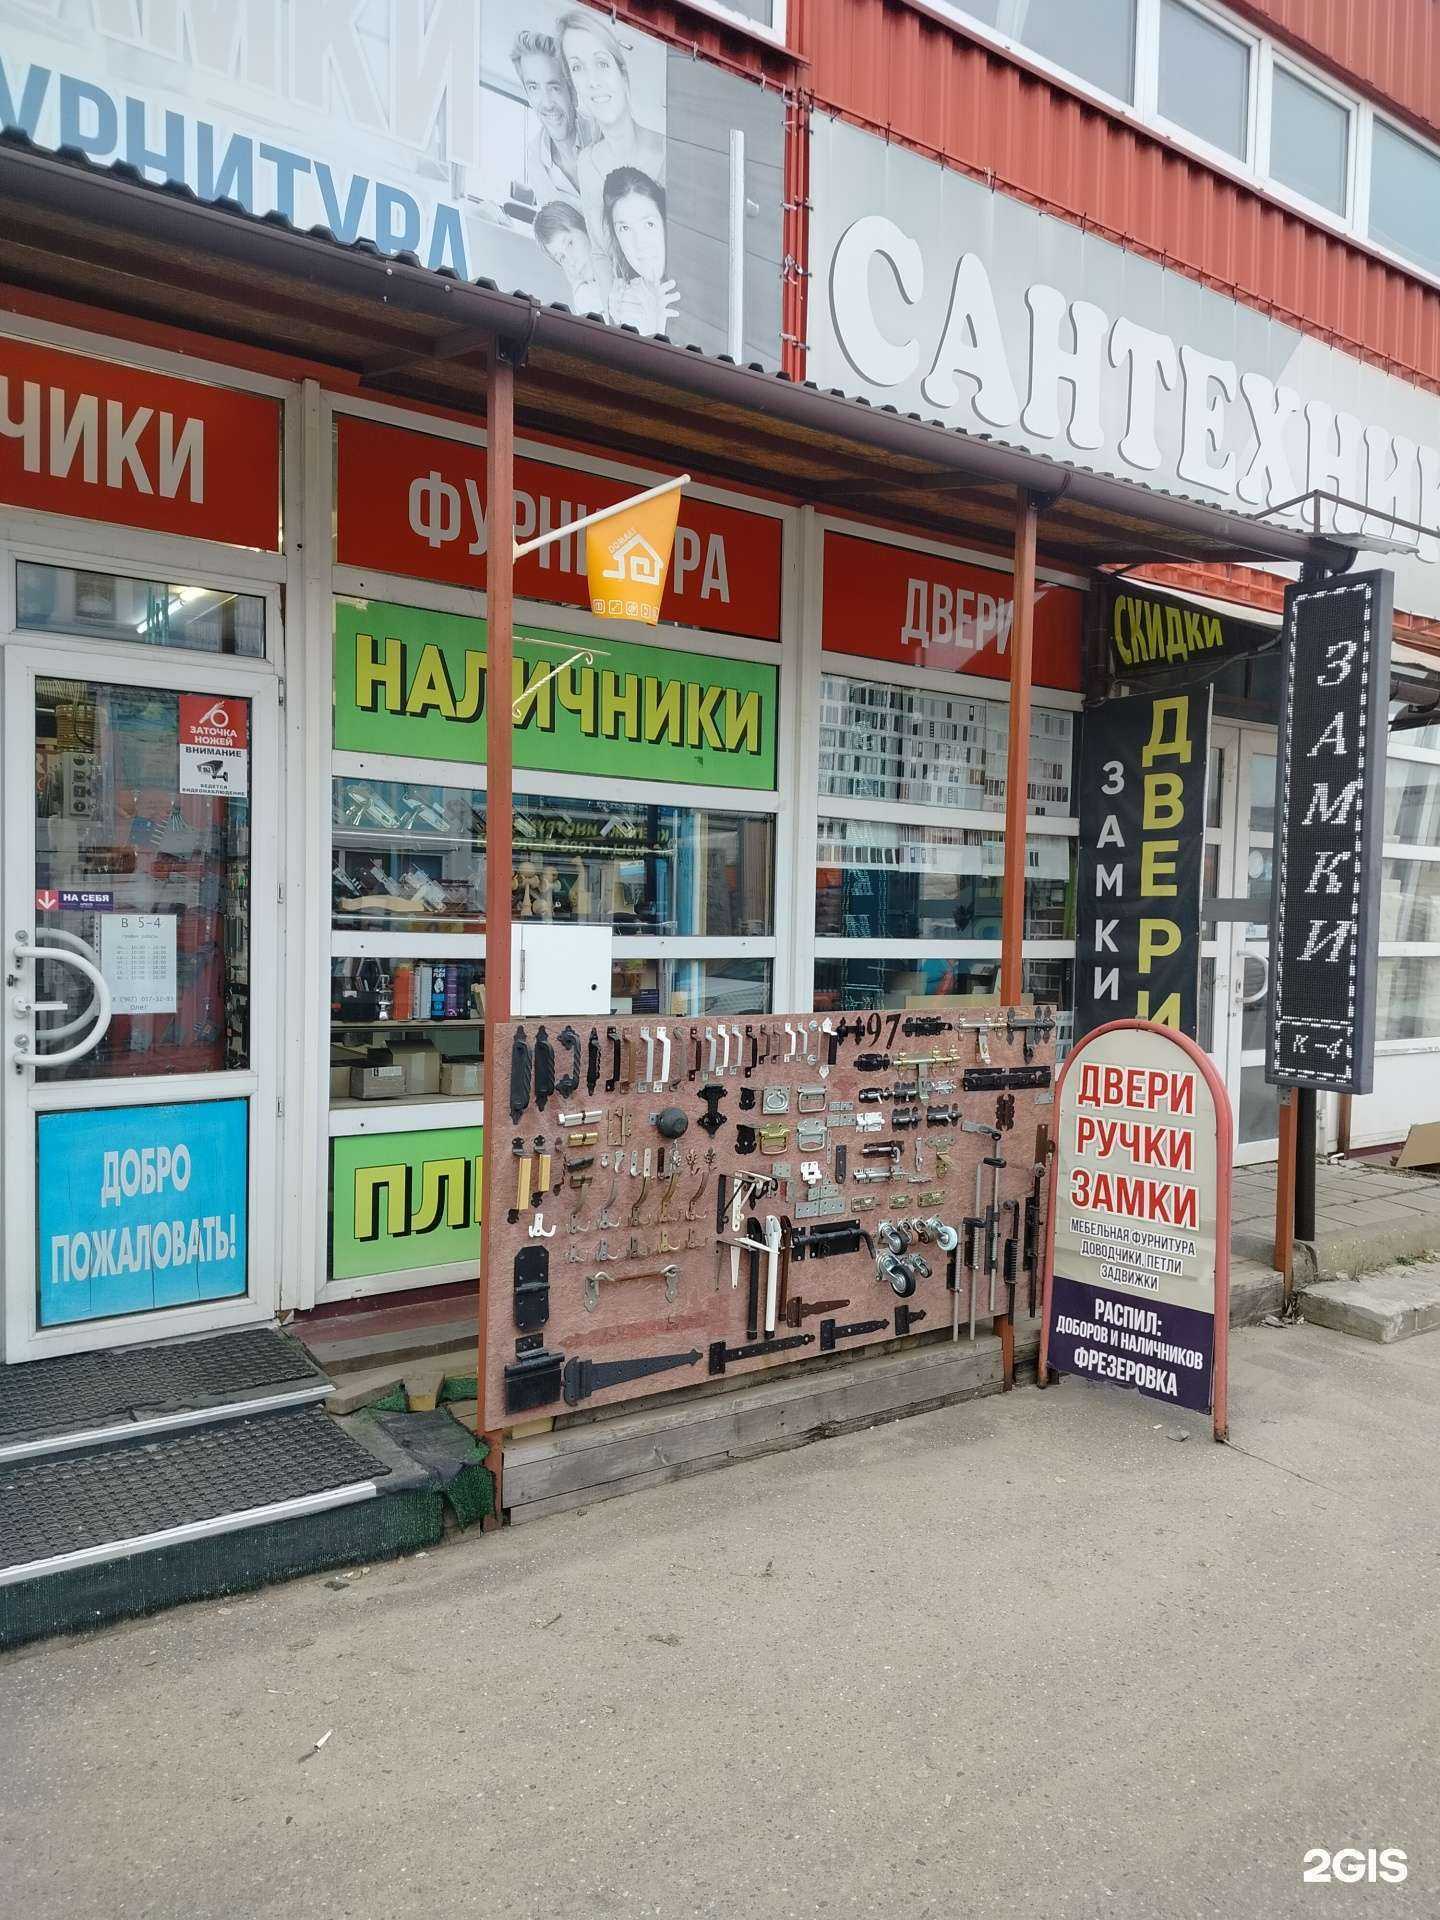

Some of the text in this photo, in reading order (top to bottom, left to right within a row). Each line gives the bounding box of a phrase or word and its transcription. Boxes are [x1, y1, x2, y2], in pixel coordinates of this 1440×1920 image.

[0, 374, 204, 504] ЧИКИ
[409, 471, 729, 603] ФУРНРА
[901, 578, 1013, 654] ДВЕРИ
[1114, 595, 1223, 665] СКИДКИ
[355, 632, 762, 756] НАЛИЧНИКИ
[185, 746, 242, 758] ВНИМАНИЕ
[190, 725, 237, 738] ЗАТОЧКА
[194, 735, 233, 747] НОЖЕЙ
[1296, 641, 1363, 962] ЗАМКИ
[1093, 761, 1125, 1001] ЗАМКИ
[1137, 695, 1192, 1030] ДВЕРИ
[63, 893, 110, 903] НА СЕБЯ
[137, 916, 161, 929] 5-4
[1078, 1064, 1194, 1115] ДВЕРИ
[1077, 1116, 1192, 1170] РУЧКИ
[100, 1143, 191, 1208] ДОБРО
[1071, 1169, 1197, 1228] ЗАМКИ
[50, 1215, 236, 1285] ПОЖАЛОВАТЬ!
[1071, 1218, 1196, 1256] МЕБЕЛЬНАЯ ФУРНИТУРА
[1082, 1240, 1182, 1275] ДОВОДЧИКИ, ПЕТЛИ
[1101, 1264, 1158, 1290] ЗАДВИЖКИ
[1056, 1315, 1204, 1370] ДОБОРОВ И НАЛИЧНИКОВ
[1094, 1298, 1162, 1337] РАСПИЛ:
[1073, 1346, 1178, 1397] ФРЕЗЕРОВКА
